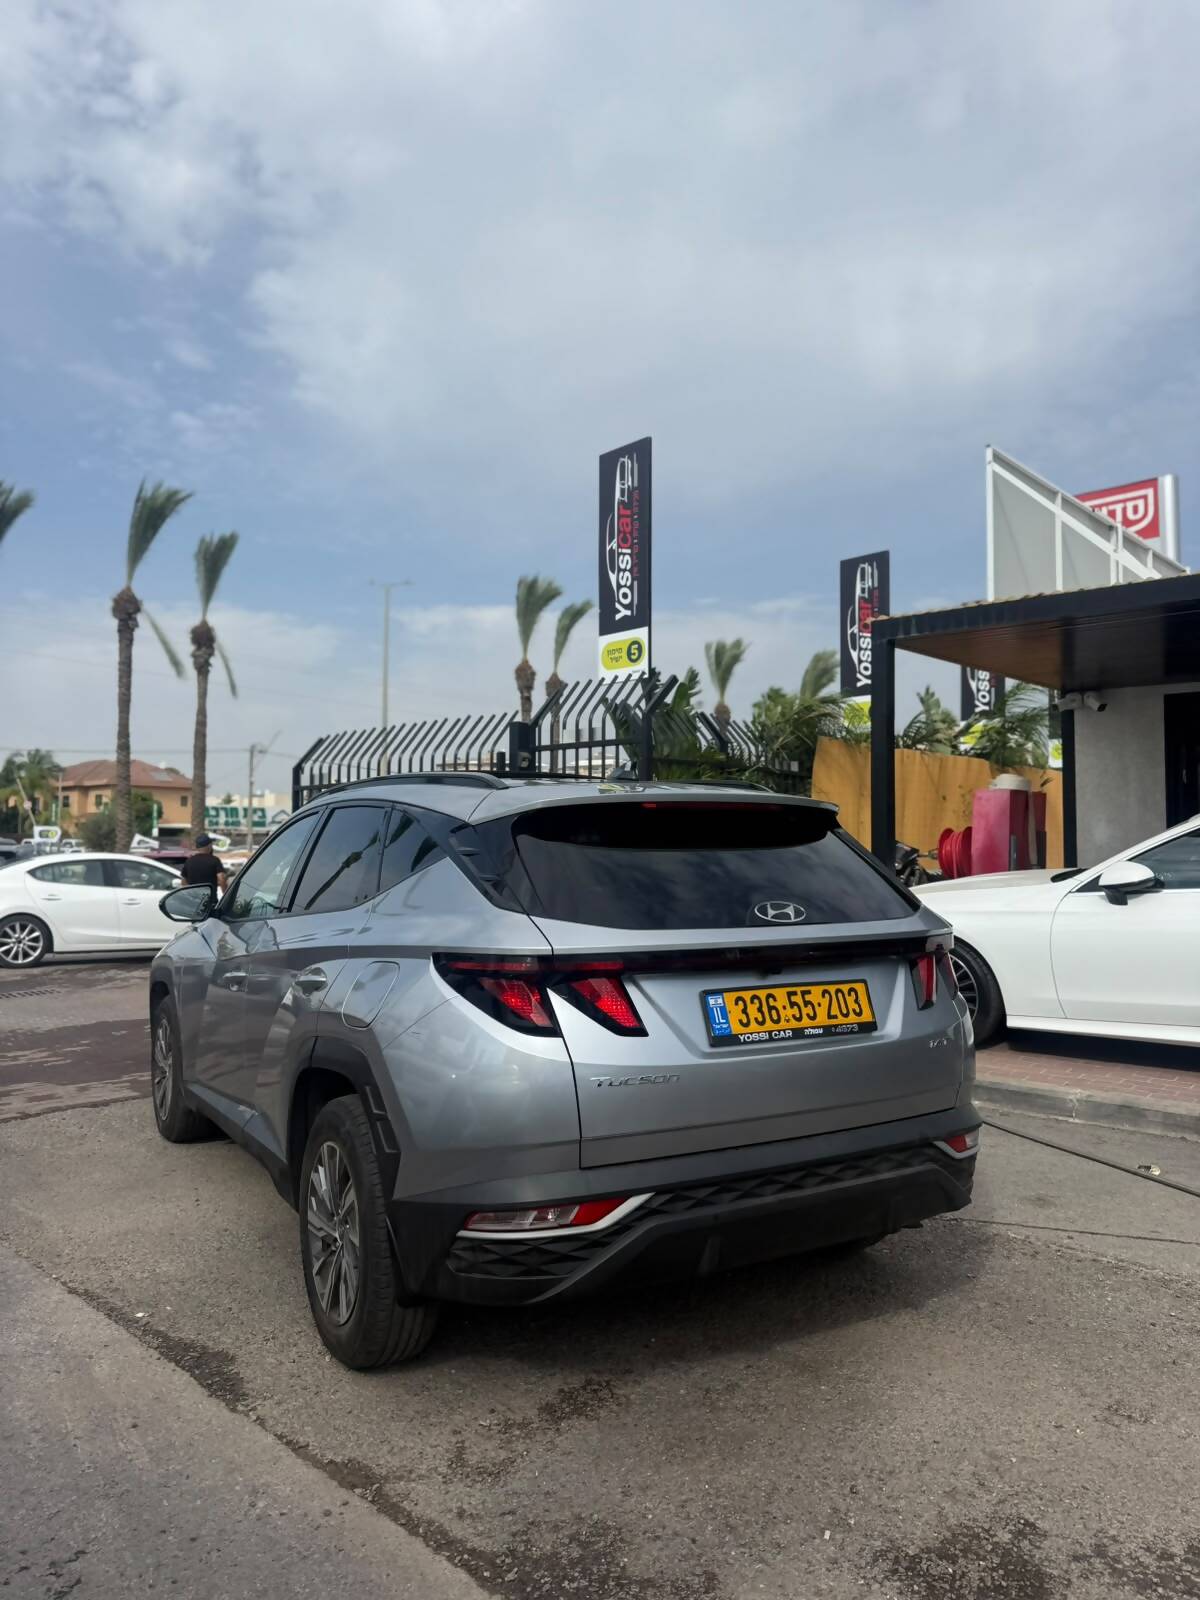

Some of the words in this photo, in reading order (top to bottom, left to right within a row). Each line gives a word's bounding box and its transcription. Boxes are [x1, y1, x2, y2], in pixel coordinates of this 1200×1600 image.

[614, 504, 632, 621] Yossicar
[631, 644, 639, 660] 5
[974, 669, 990, 713] Yoss
[713, 1007, 726, 1023] IL
[738, 1031, 769, 1043] YOSSI
[772, 1029, 793, 1040] CAR
[804, 1027, 824, 1036] עפולה
